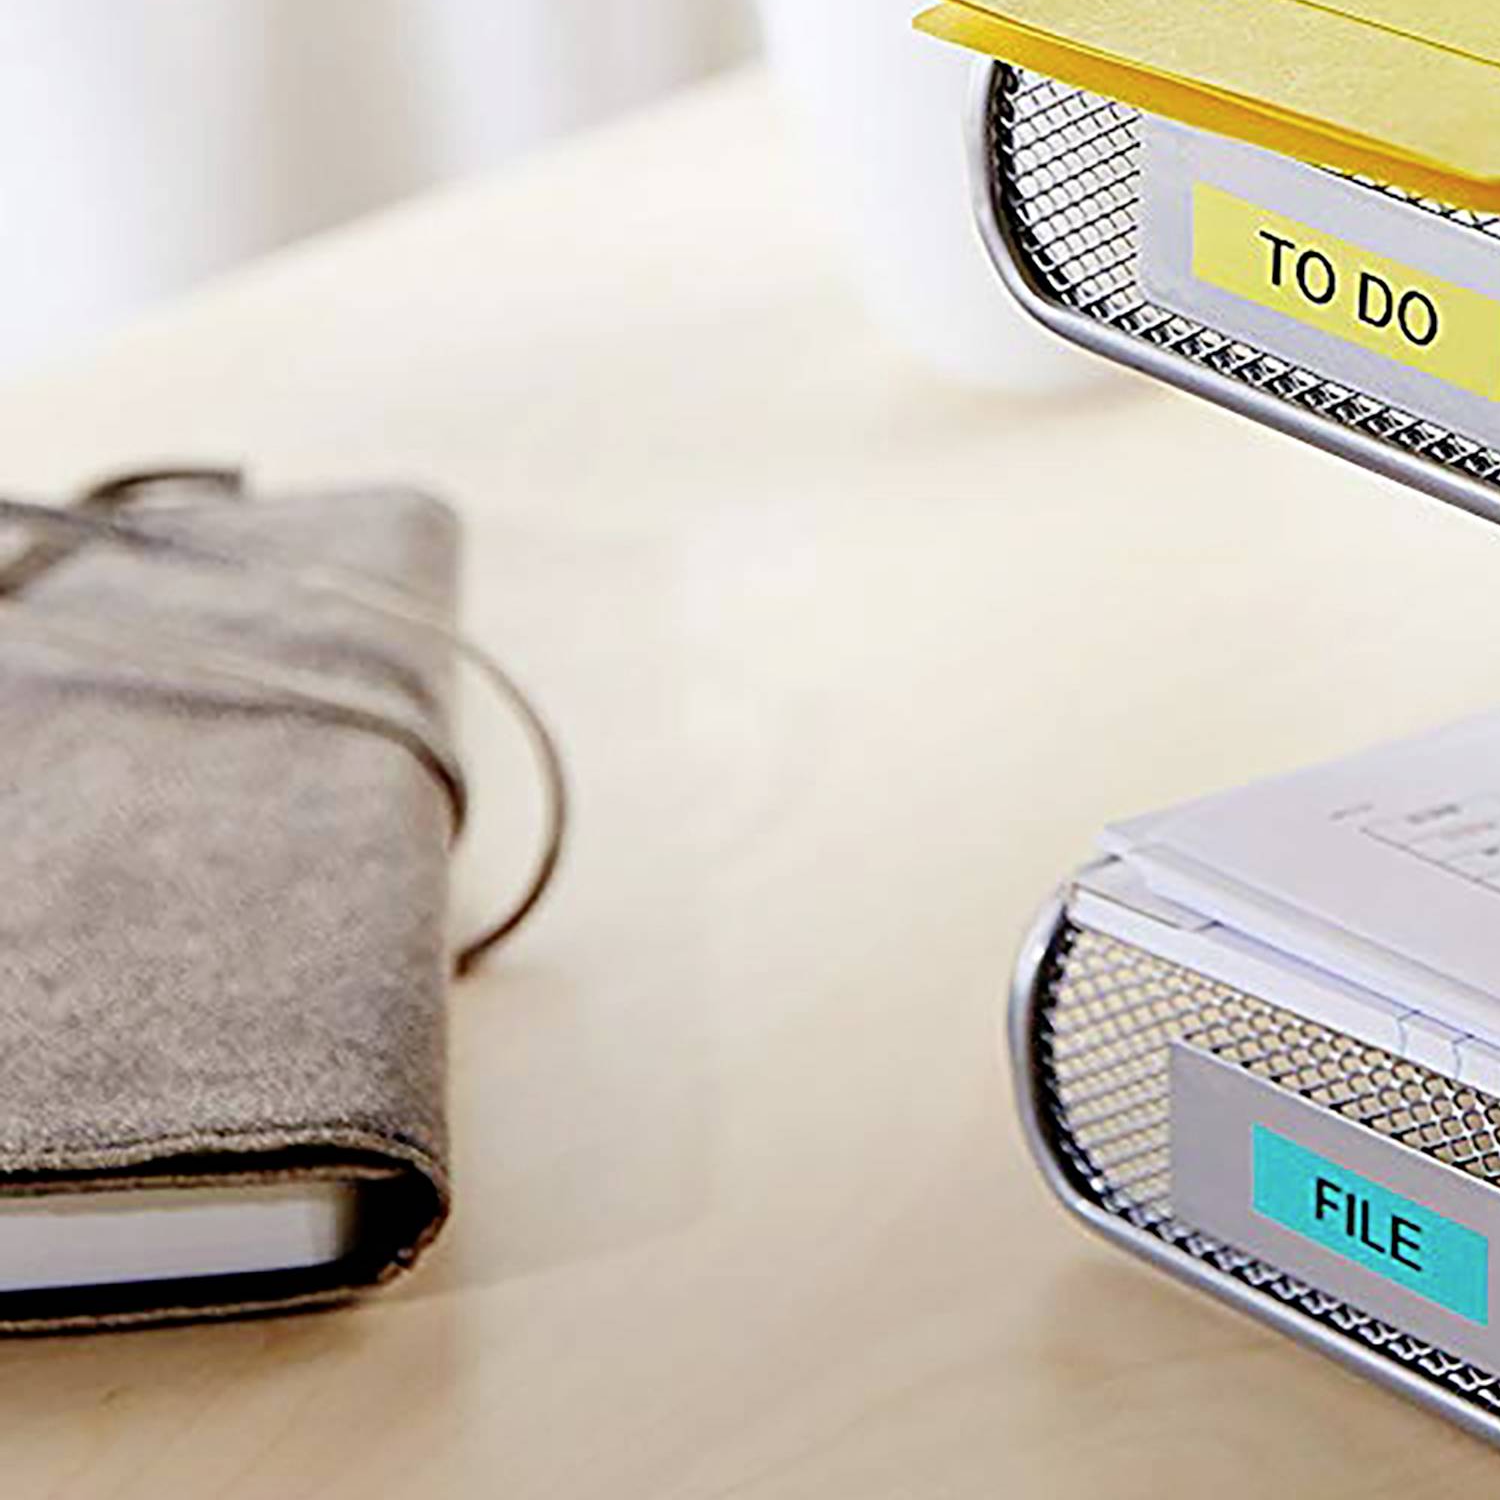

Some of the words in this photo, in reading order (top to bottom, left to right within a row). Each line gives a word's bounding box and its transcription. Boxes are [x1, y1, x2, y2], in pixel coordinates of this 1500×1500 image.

[1260, 231, 1336, 304] TO
[1358, 273, 1438, 346] DO
[1315, 1177, 1422, 1272] FILE
